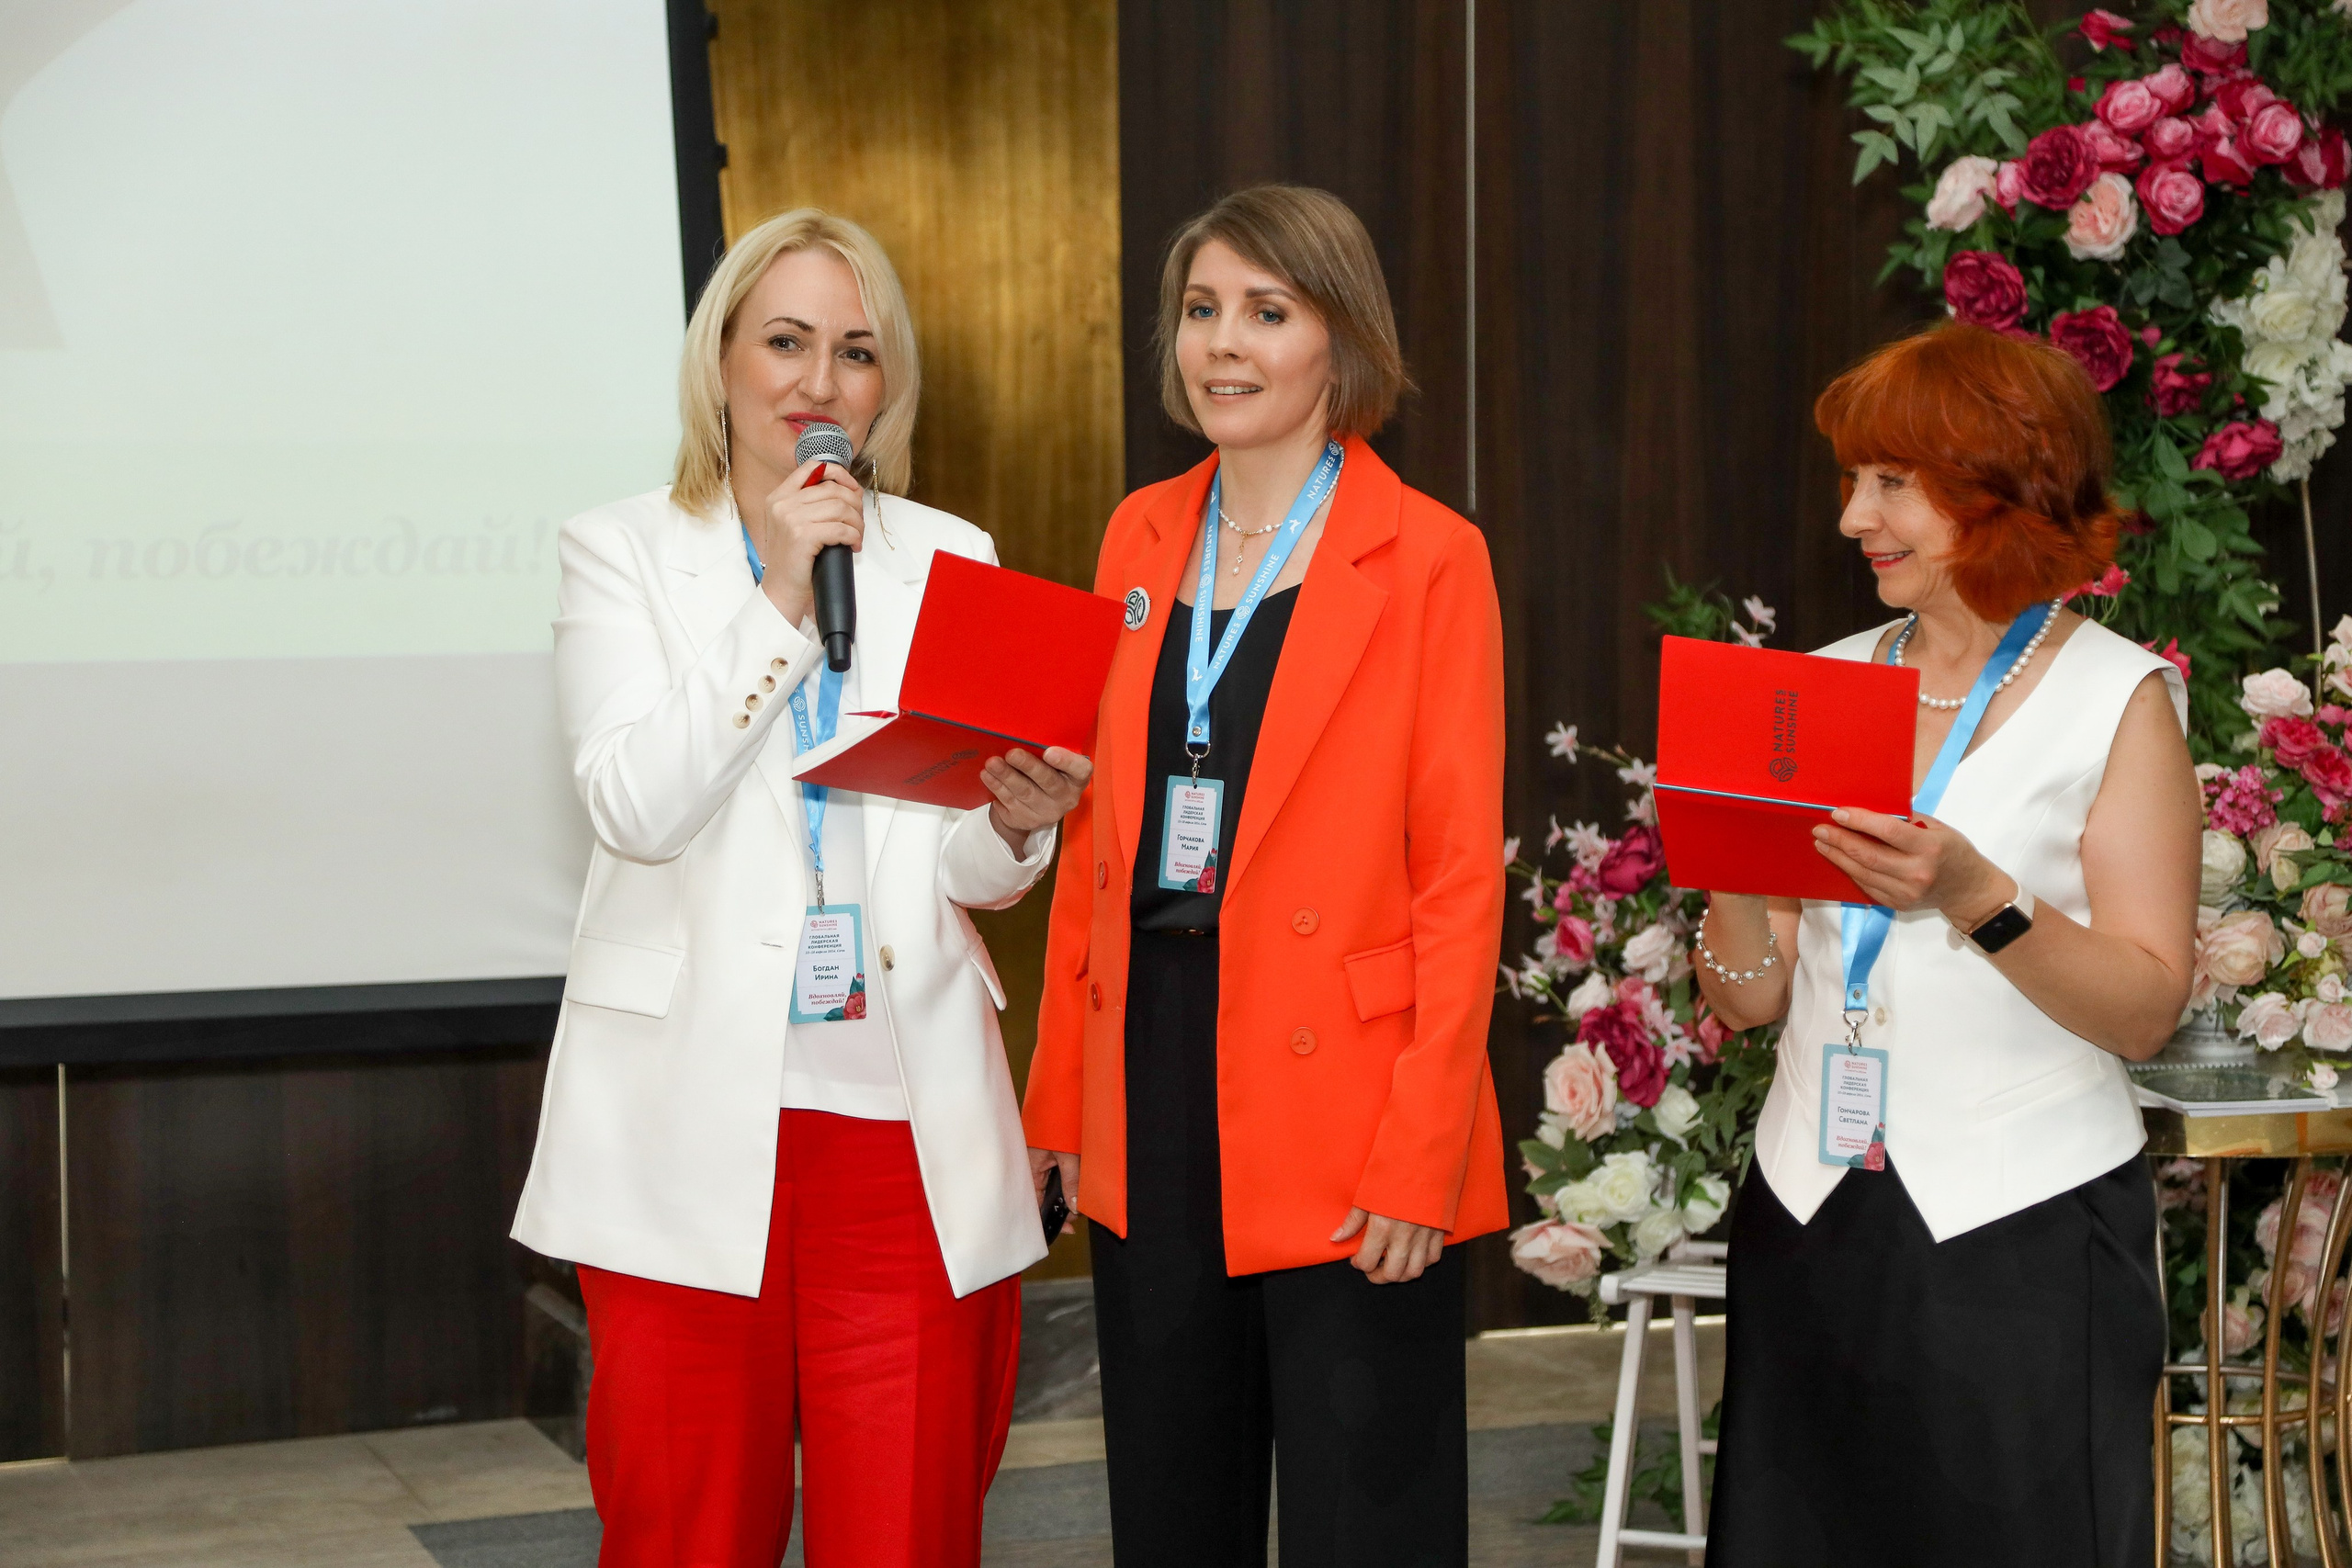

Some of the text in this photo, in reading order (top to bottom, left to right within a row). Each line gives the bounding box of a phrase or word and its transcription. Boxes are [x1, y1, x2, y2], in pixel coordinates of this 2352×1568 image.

[87, 514, 548, 581] побеждай!
[1195, 589, 1207, 643] SUNSHINE
[1213, 553, 1280, 670] NATURES SUNSHINE
[797, 715, 810, 752] SUNSH
[1773, 689, 1786, 751] NATURES
[1786, 691, 1799, 753] SUNSHINE
